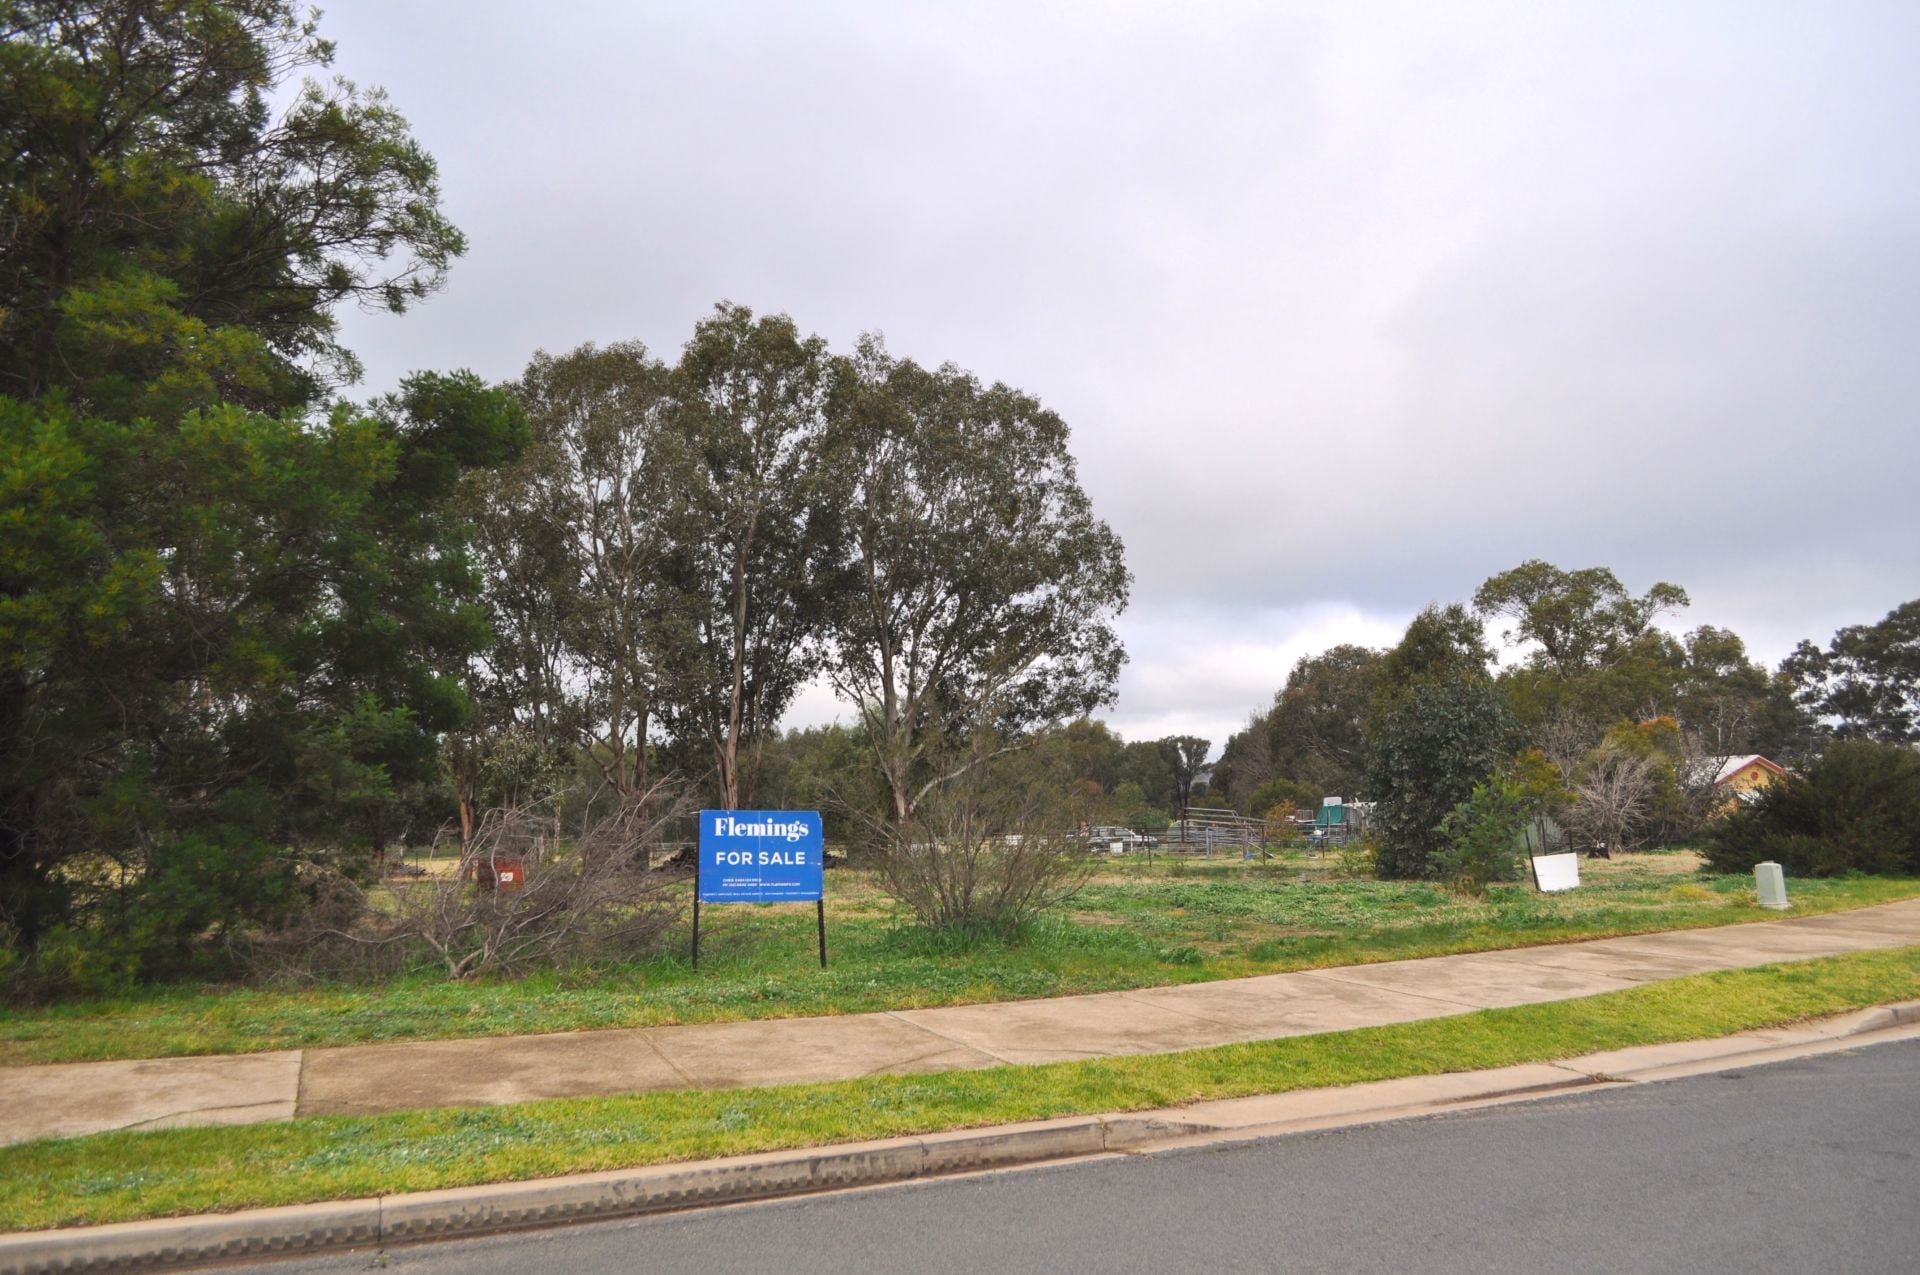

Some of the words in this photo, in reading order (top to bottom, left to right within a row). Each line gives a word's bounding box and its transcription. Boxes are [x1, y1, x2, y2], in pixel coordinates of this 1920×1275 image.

[714, 817, 809, 842] Flemings
[716, 851, 753, 865] FOR
[758, 851, 806, 865] SALE
